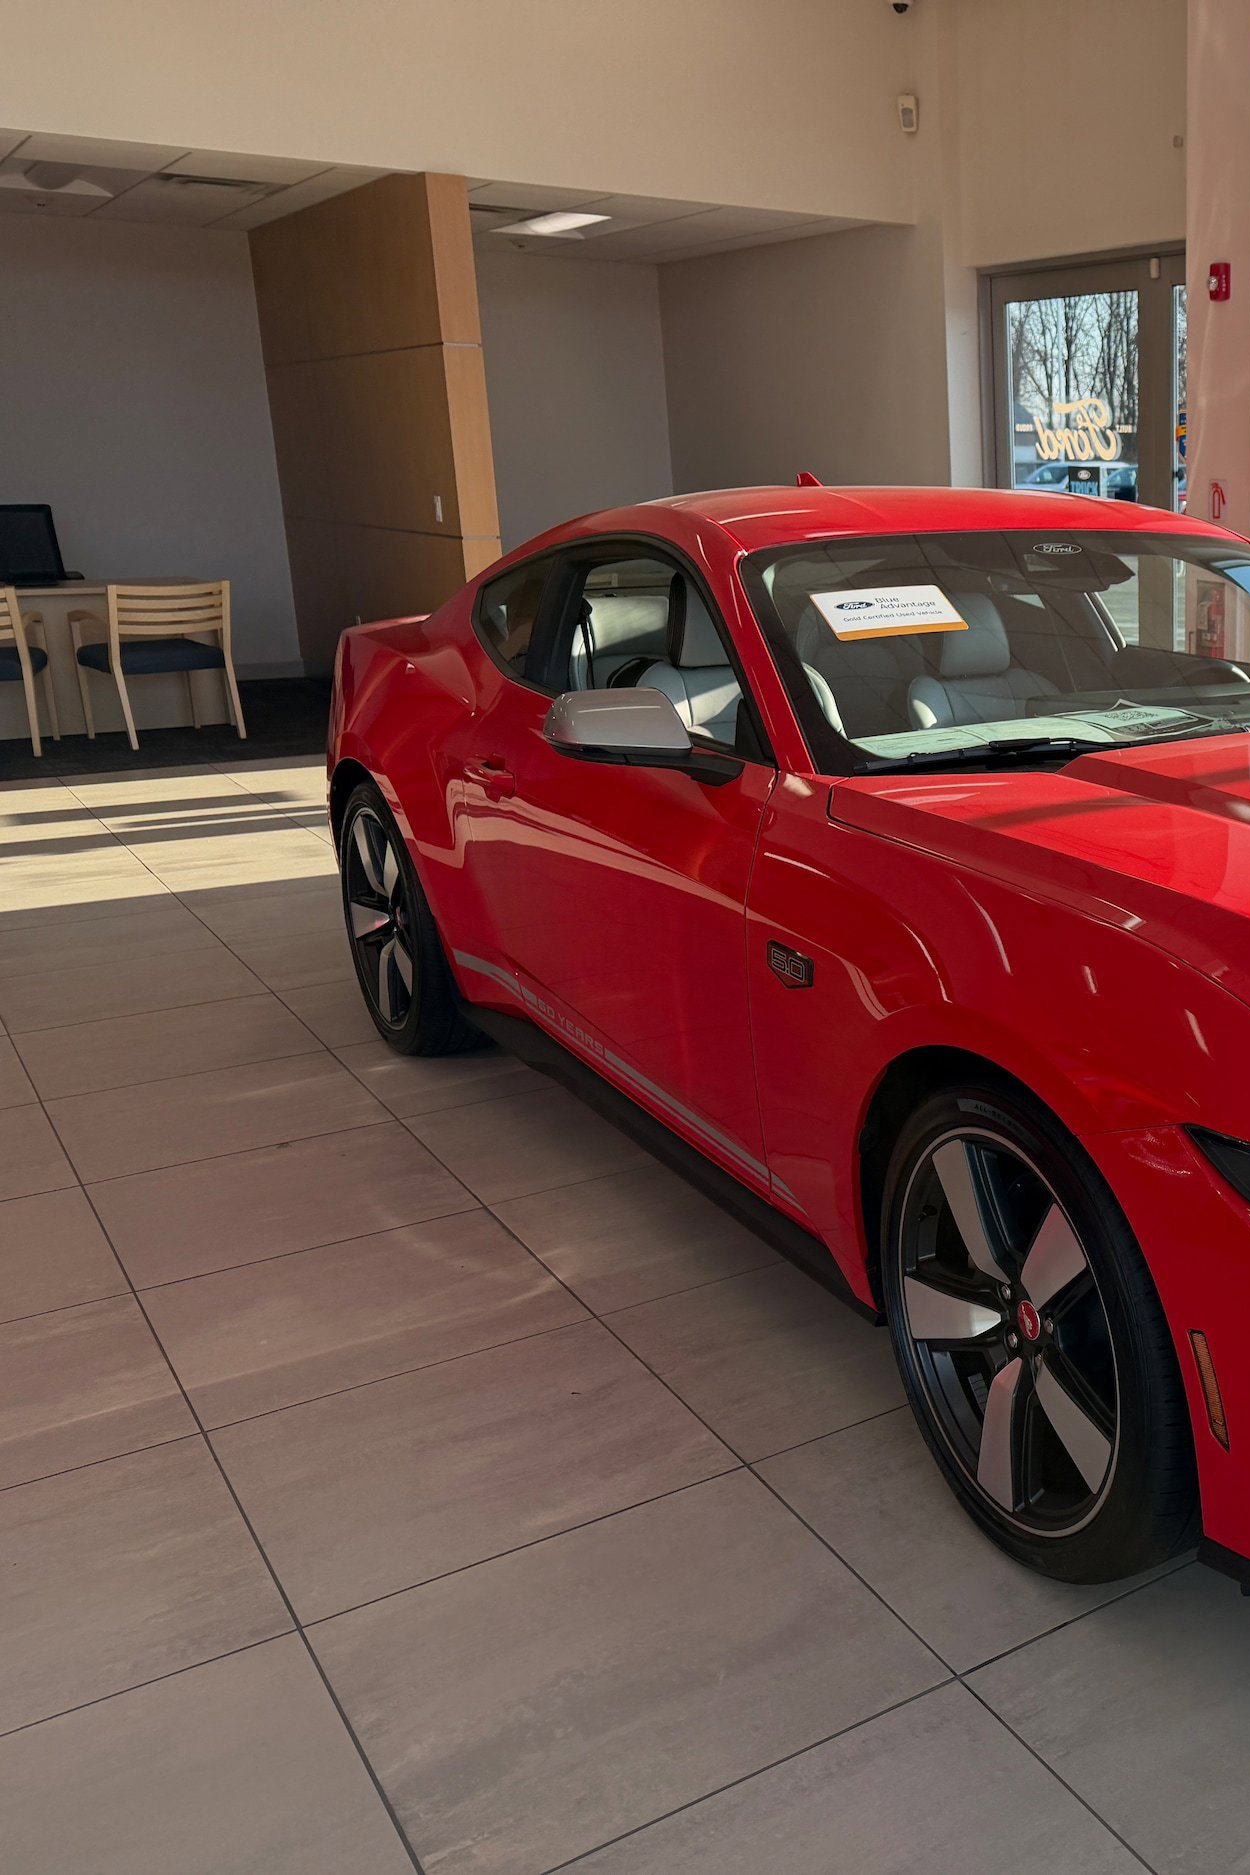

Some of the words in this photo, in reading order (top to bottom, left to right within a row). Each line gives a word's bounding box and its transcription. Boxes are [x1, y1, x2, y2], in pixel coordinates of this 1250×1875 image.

[1040, 543, 1076, 554] Ford
[841, 602, 870, 610] Ford
[880, 600, 936, 610] Advantage
[770, 947, 806, 983] 5.0
[557, 1012, 603, 1055] YEARS
